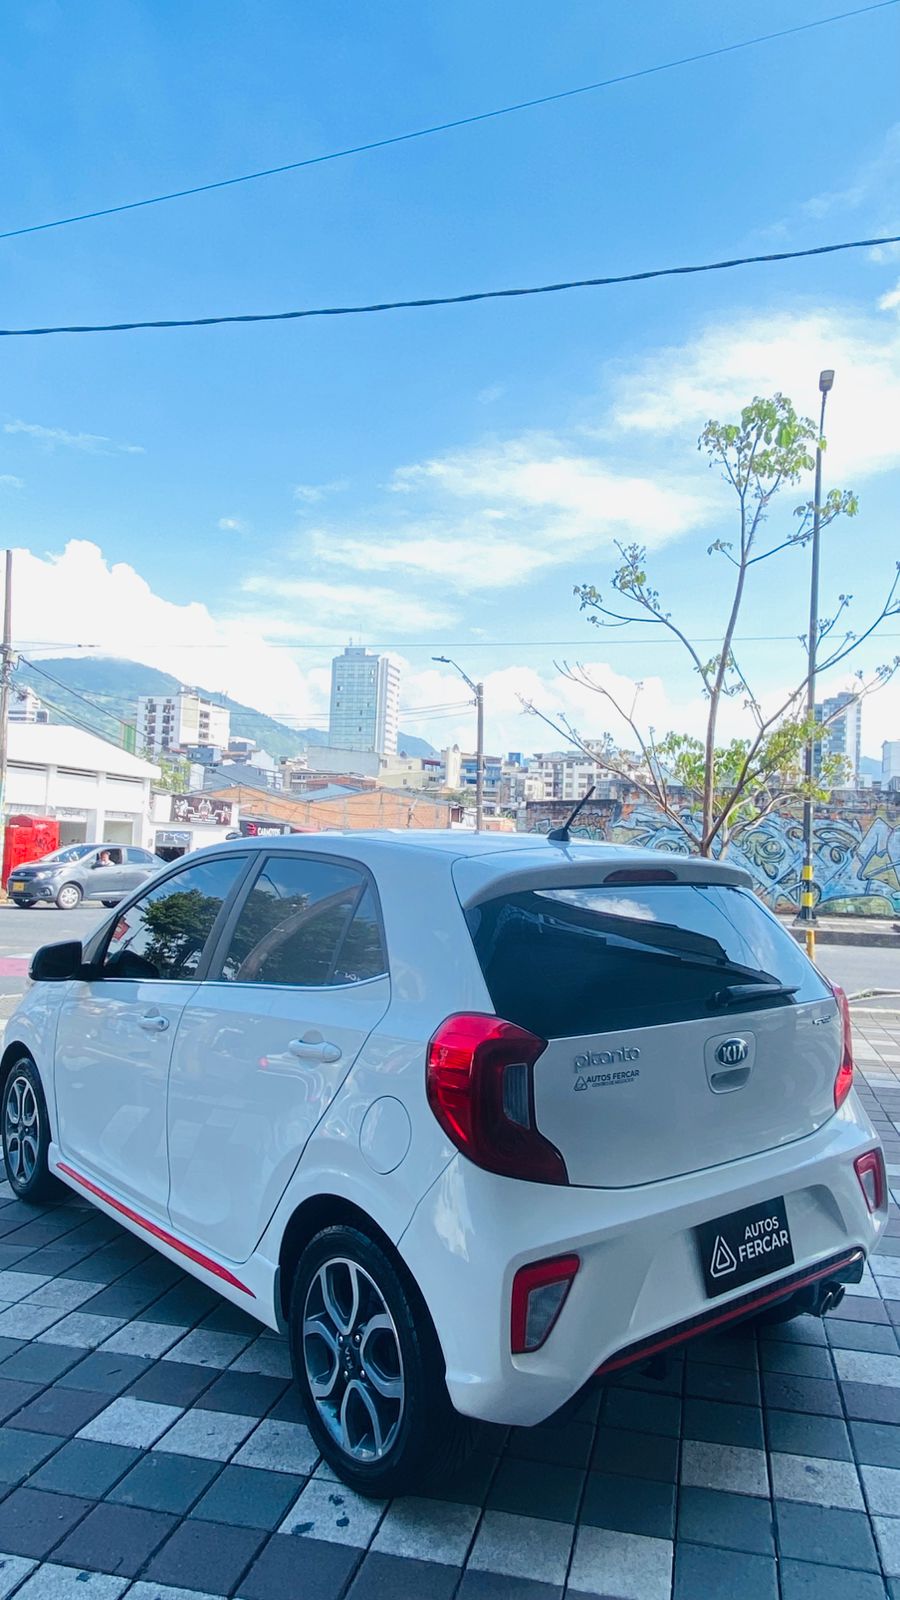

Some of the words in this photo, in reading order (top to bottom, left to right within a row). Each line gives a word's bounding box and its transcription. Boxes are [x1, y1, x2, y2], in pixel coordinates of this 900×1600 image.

[722, 1044, 746, 1062] KIA
[586, 1073, 612, 1083] AUTOS
[612, 1069, 640, 1080] FERCAR
[744, 1216, 779, 1240] AUTOS
[738, 1230, 789, 1262] FERCAR
